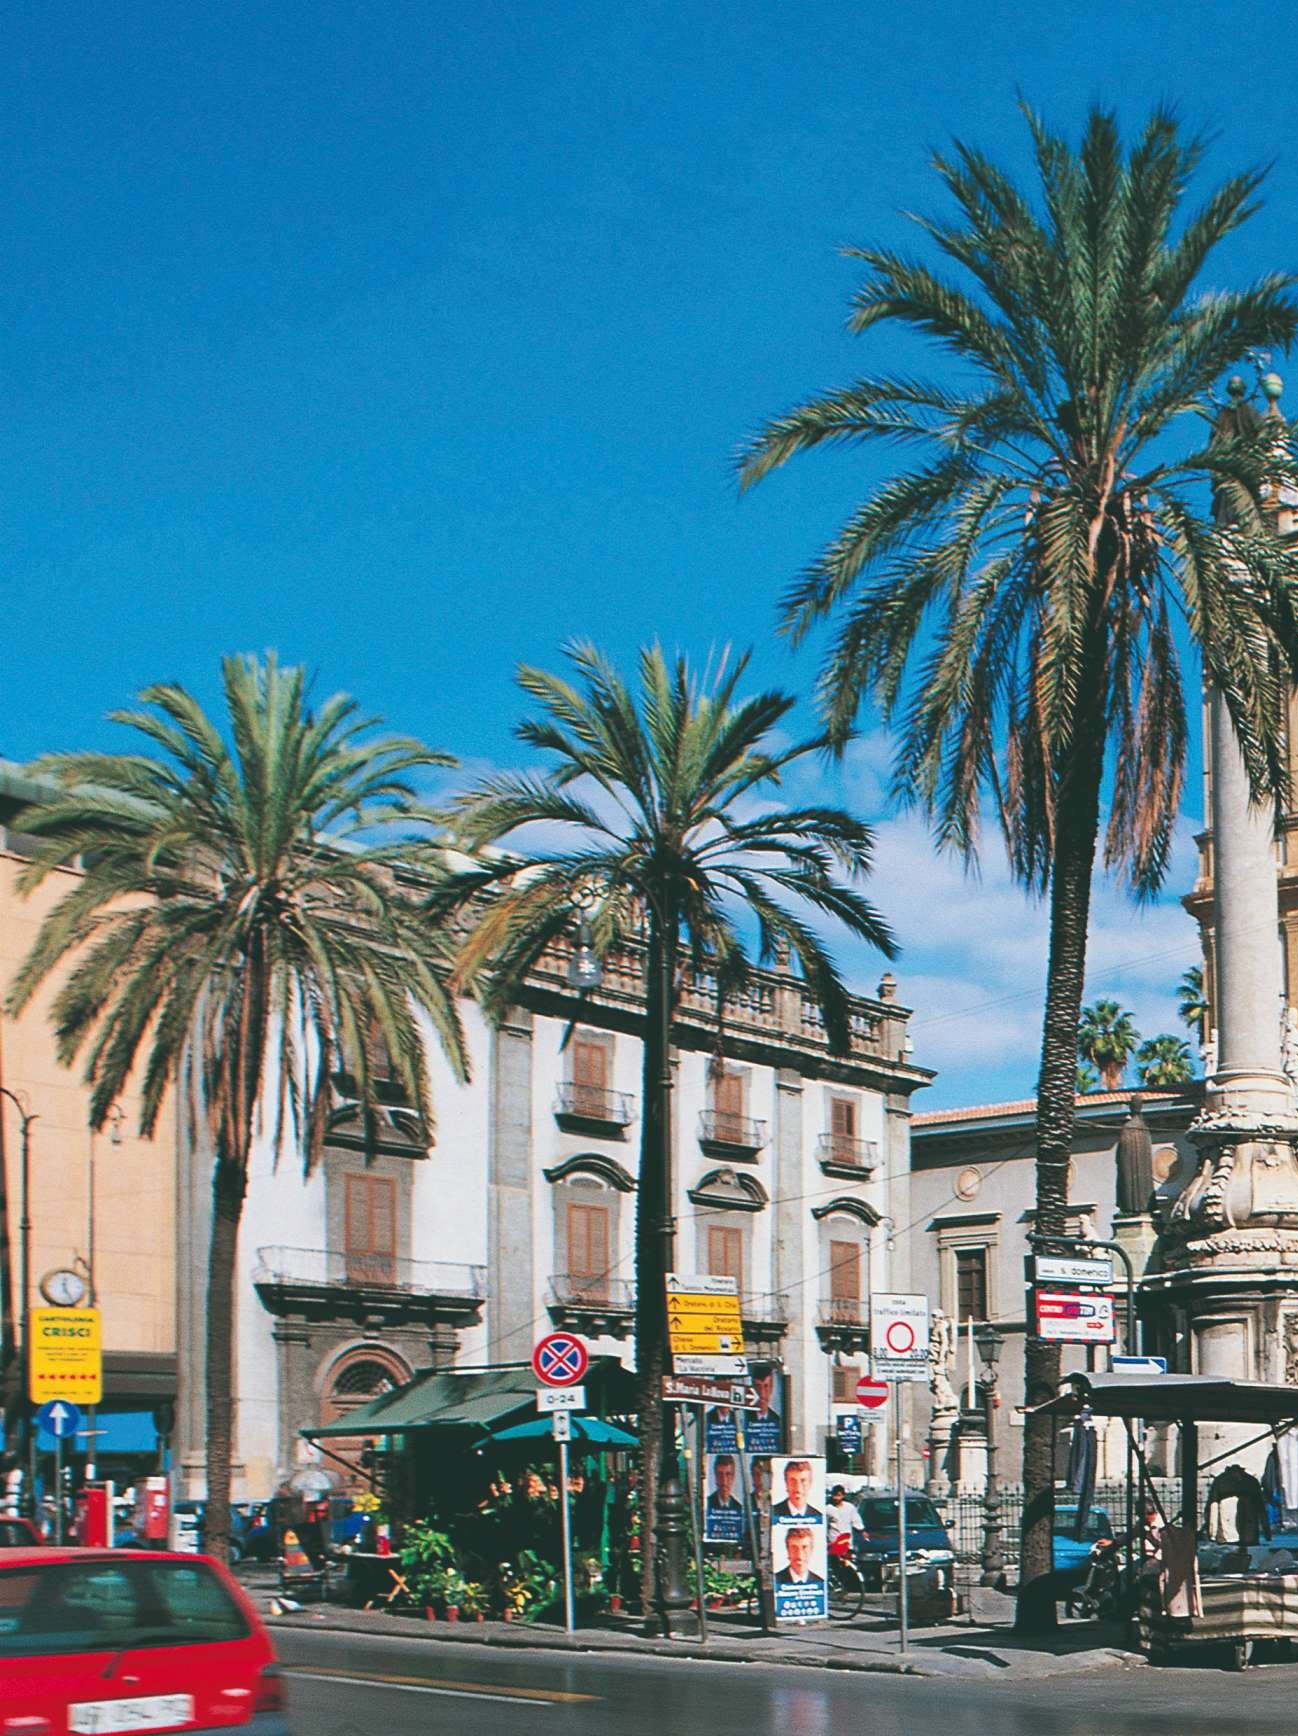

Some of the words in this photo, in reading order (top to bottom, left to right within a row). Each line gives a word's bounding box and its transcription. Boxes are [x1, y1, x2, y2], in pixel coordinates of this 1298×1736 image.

[1071, 1268, 1109, 1277] domenico
[43, 1327, 90, 1337] CRISCI
[547, 1395, 575, 1404] 0-24
